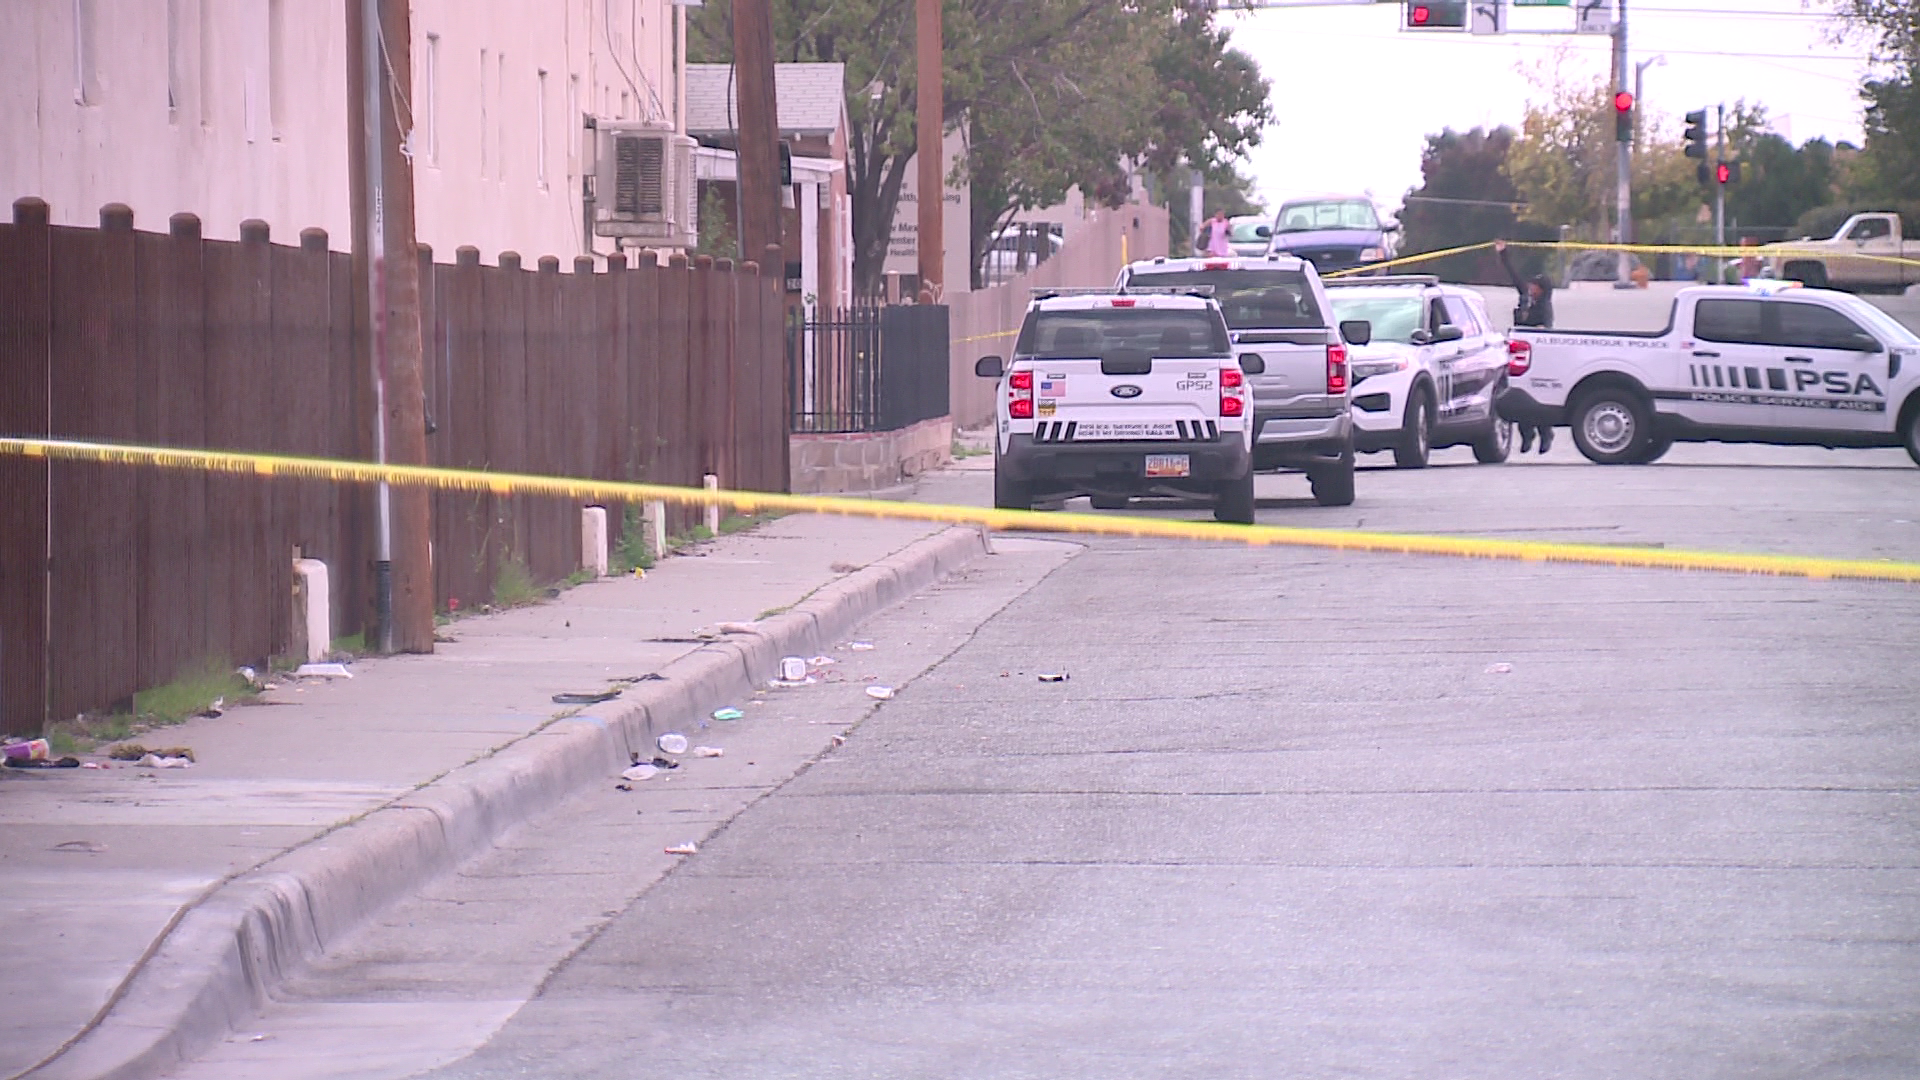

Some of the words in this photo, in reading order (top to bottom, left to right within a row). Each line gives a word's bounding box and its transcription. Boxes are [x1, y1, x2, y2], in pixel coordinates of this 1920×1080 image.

[1535, 337, 1623, 347] ALBUQUERQUE
[1628, 340, 1669, 349] POLICE
[1793, 369, 1884, 397] PSA
[1690, 393, 1748, 404] POLICE
[1757, 396, 1832, 408] SERVICE
[1837, 401, 1877, 411] AIDE
